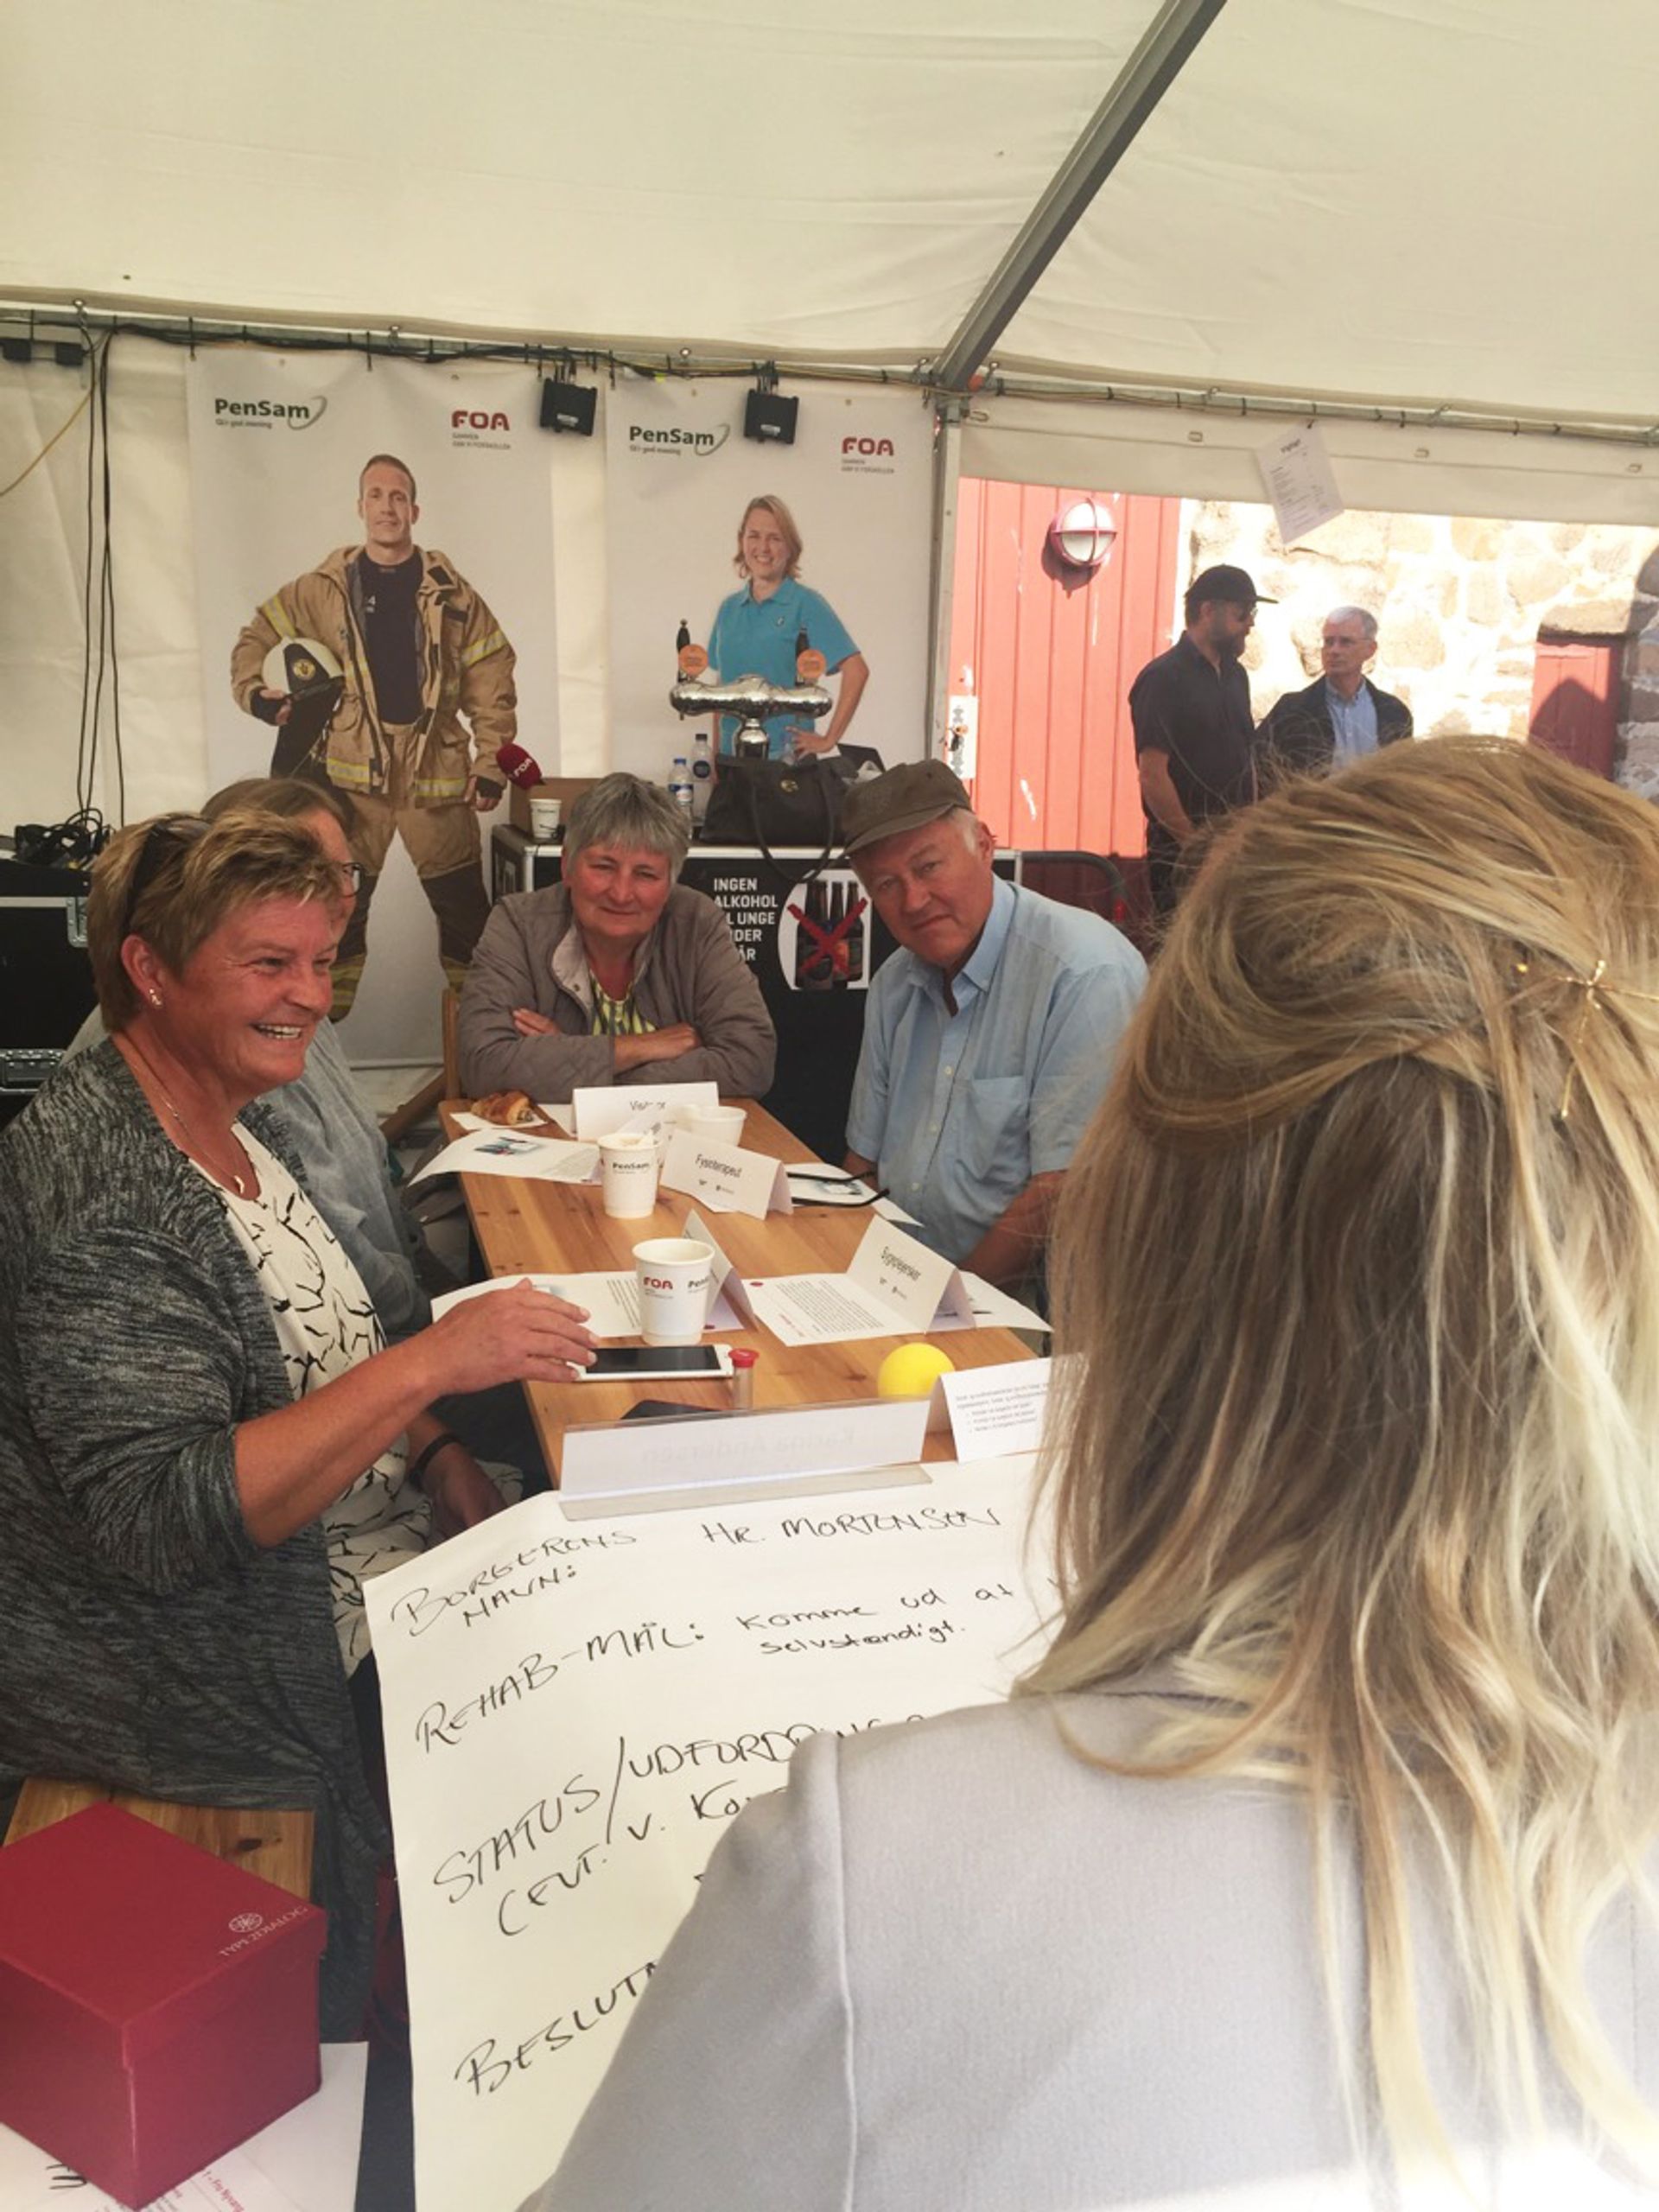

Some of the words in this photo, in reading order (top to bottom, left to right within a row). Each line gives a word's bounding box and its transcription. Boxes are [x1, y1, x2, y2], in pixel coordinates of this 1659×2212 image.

[215, 398, 309, 419] PenSam
[452, 410, 510, 431] FOA
[630, 426, 714, 446] PenSam
[842, 437, 894, 456] FOA
[714, 878, 758, 892] INGEN
[714, 895, 778, 908] ALKOHOL
[737, 912, 775, 925] UNGE
[729, 929, 762, 942] DER
[644, 1277, 673, 1290] FOA
